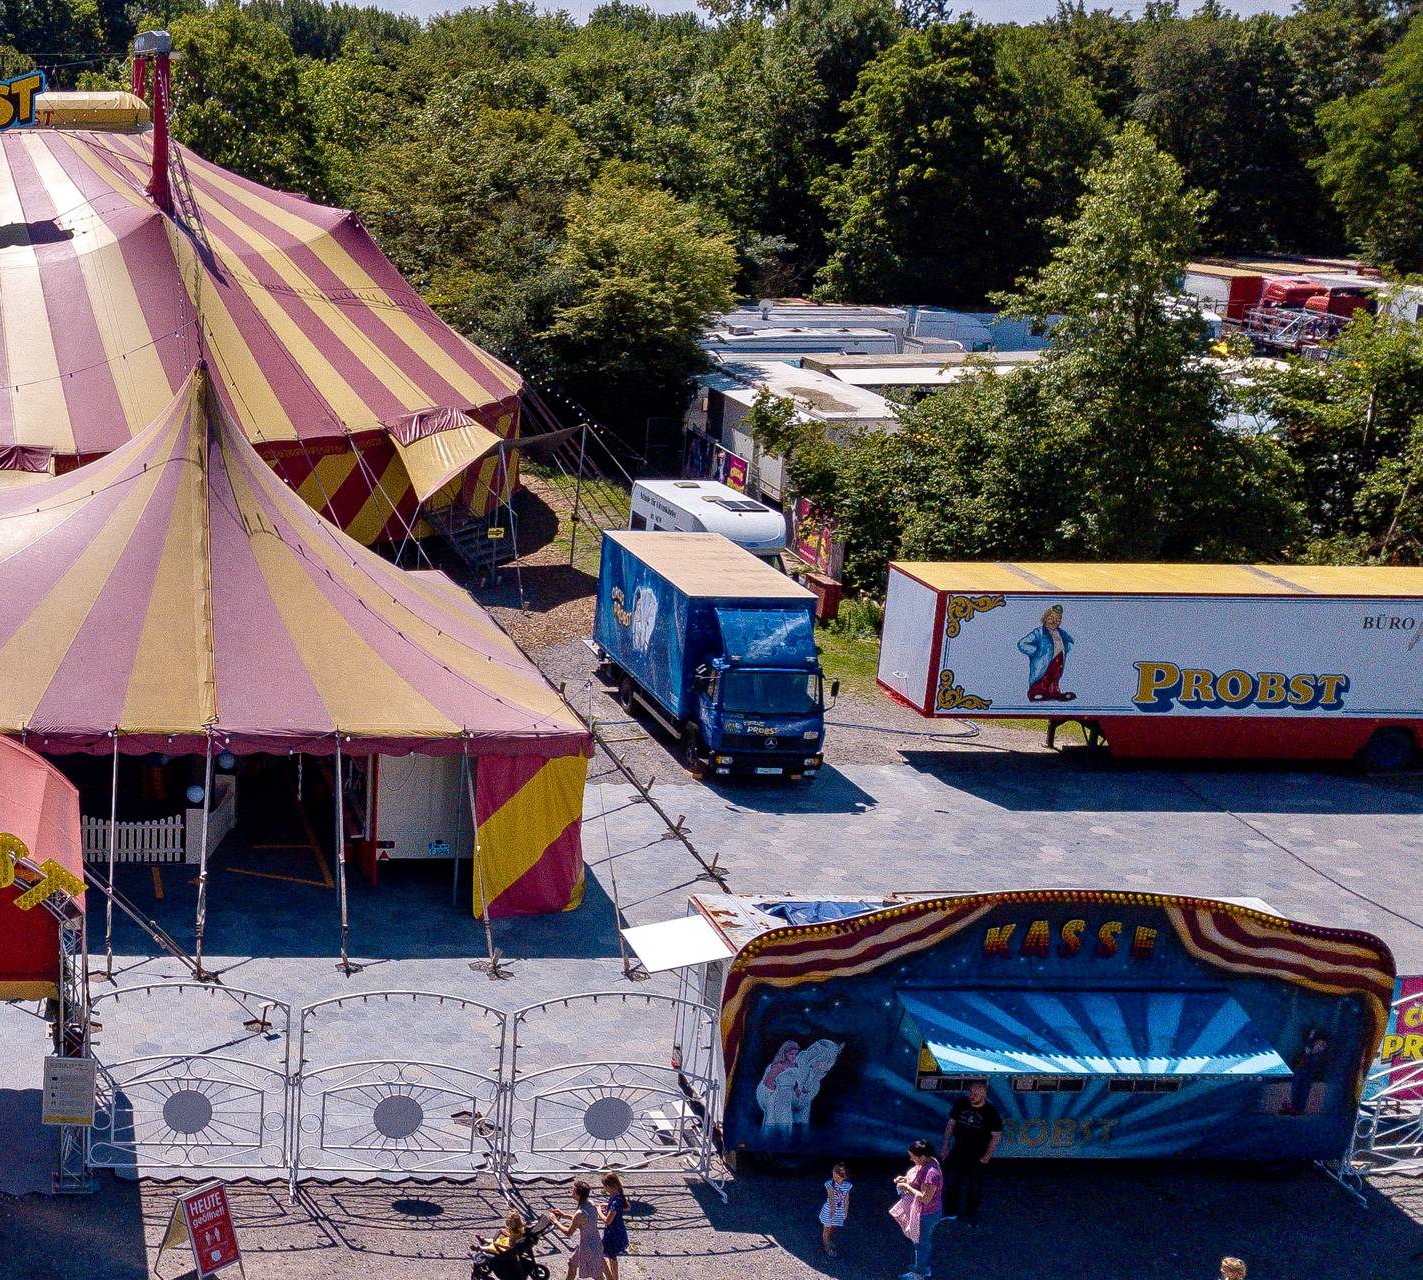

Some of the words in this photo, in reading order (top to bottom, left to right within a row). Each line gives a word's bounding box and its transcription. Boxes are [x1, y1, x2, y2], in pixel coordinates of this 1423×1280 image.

[1362, 613, 1415, 630] BÜRO
[1132, 661, 1349, 709] PROBST
[985, 919, 1158, 959] KASSE
[190, 1192, 223, 1217] HEUTE
